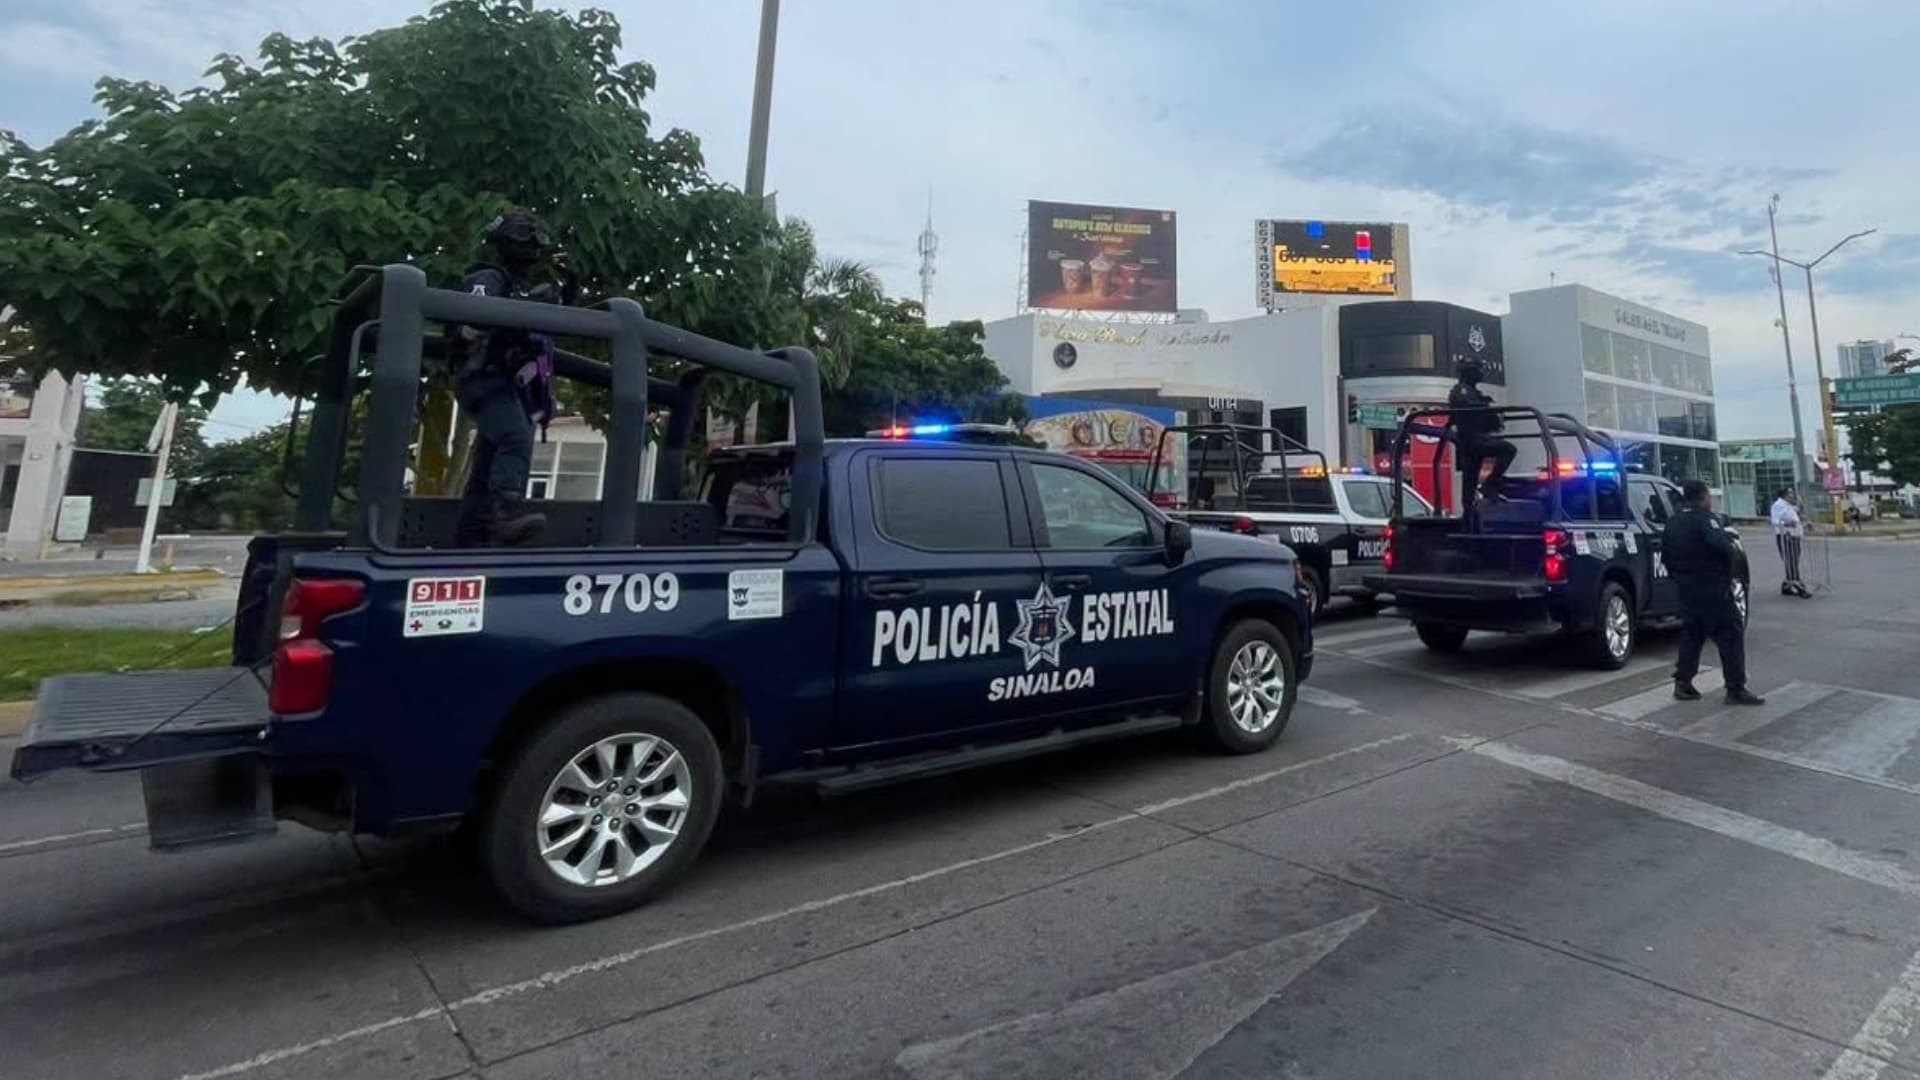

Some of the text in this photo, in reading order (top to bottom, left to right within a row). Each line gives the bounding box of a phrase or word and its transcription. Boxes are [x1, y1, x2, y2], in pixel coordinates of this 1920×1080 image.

[416, 582, 476, 600] 911
[563, 572, 679, 615] 8709
[872, 588, 1174, 667] POLICÍA ESTATAL
[987, 666, 1095, 702] SINALOA
